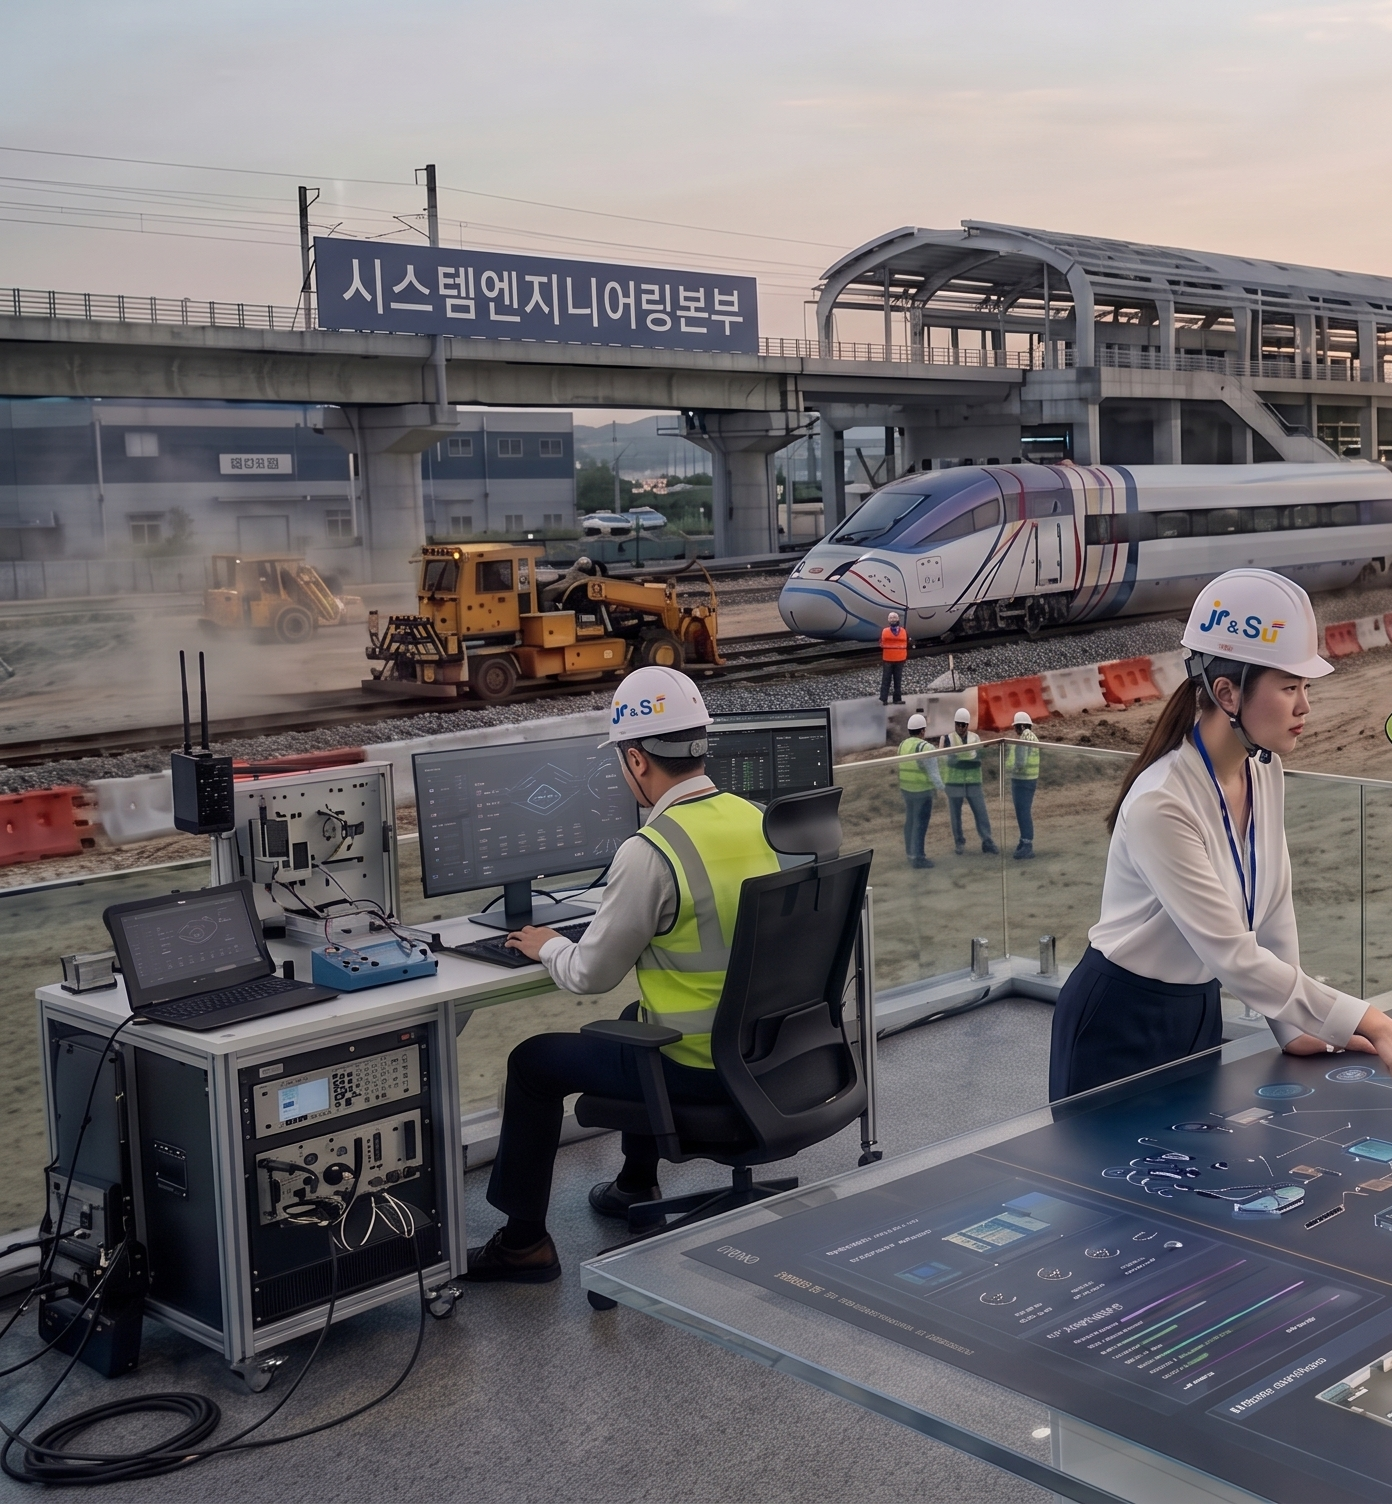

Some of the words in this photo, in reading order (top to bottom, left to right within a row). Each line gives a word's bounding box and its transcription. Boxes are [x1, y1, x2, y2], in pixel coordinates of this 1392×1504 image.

[342, 258, 744, 336] 시스템엔지니어링본부
[1227, 620, 1239, 634] &
[630, 708, 638, 717] &
